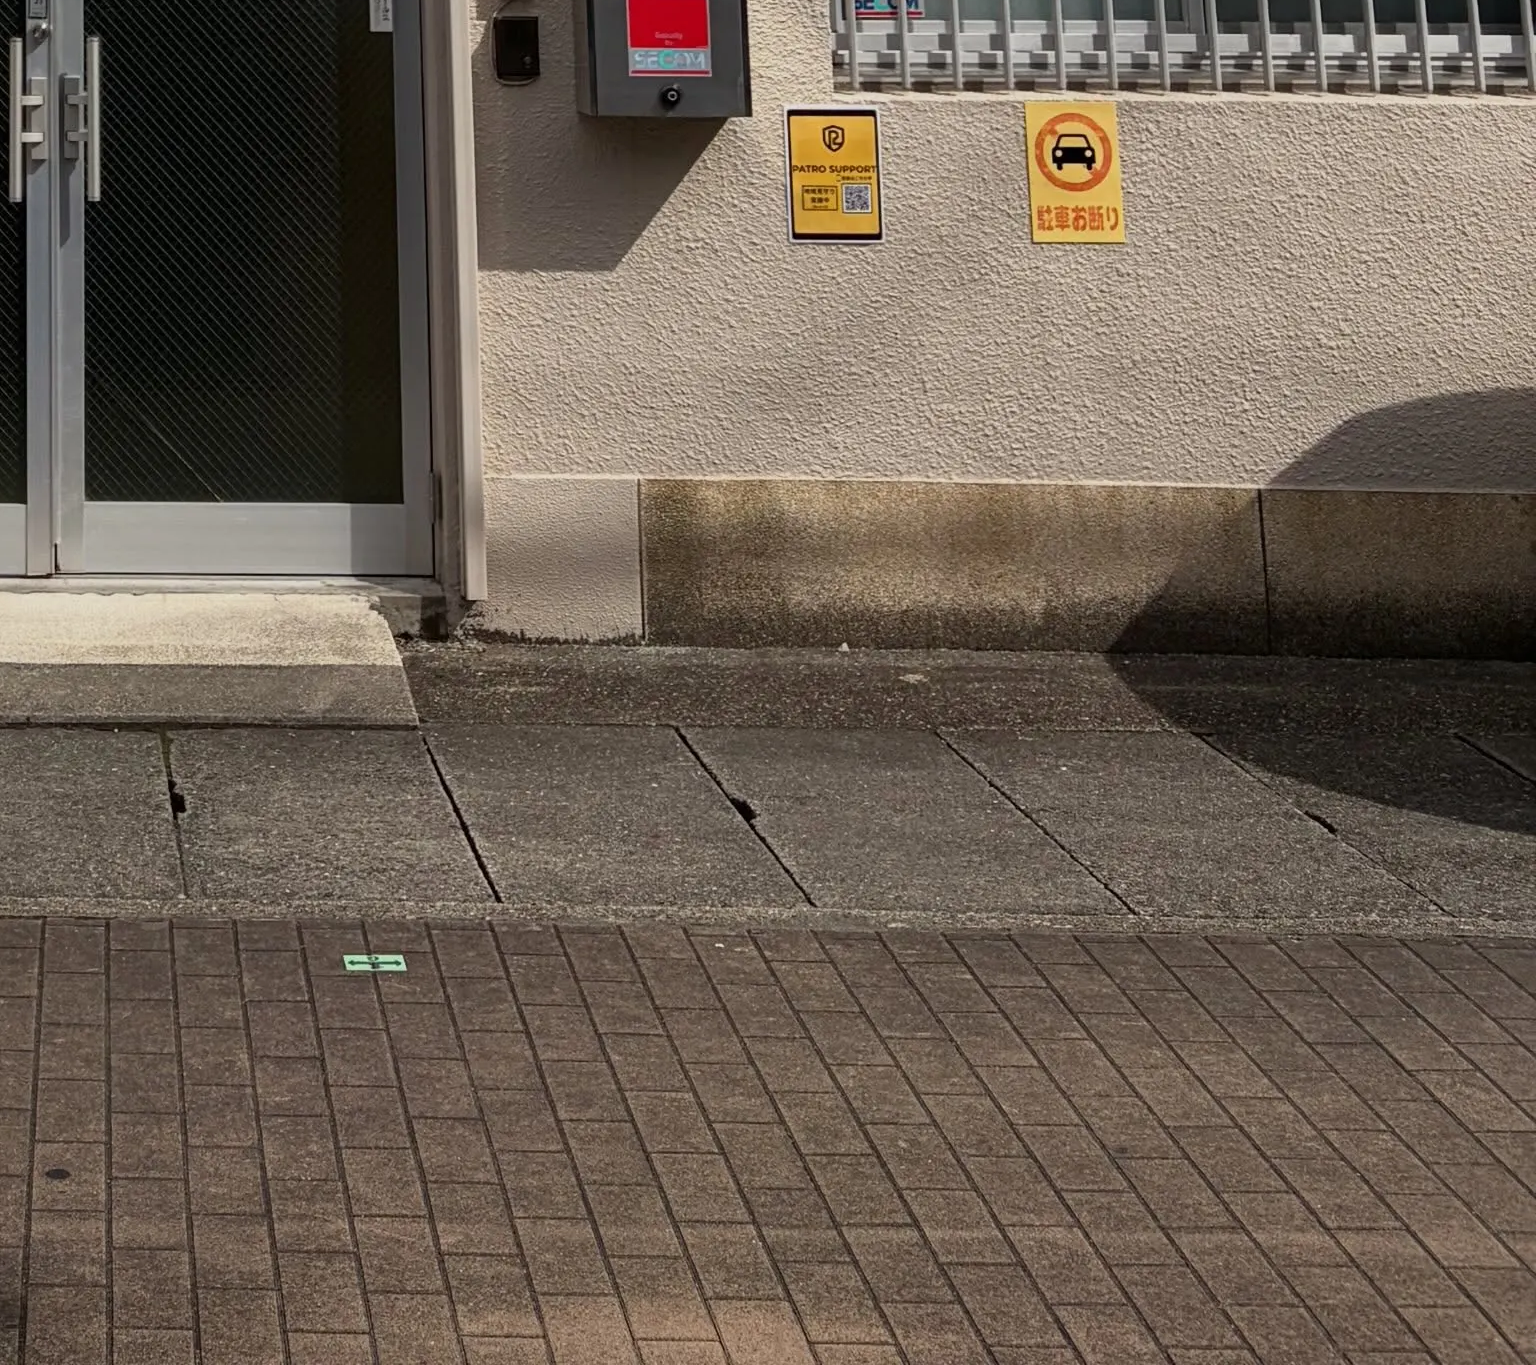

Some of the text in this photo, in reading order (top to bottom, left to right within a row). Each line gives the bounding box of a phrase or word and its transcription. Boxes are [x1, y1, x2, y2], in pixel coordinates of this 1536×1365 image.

[634, 50, 705, 70] SECOM
[792, 165, 876, 173] PATRO SUPPORT
[1037, 205, 1119, 231] 駐車お断り
